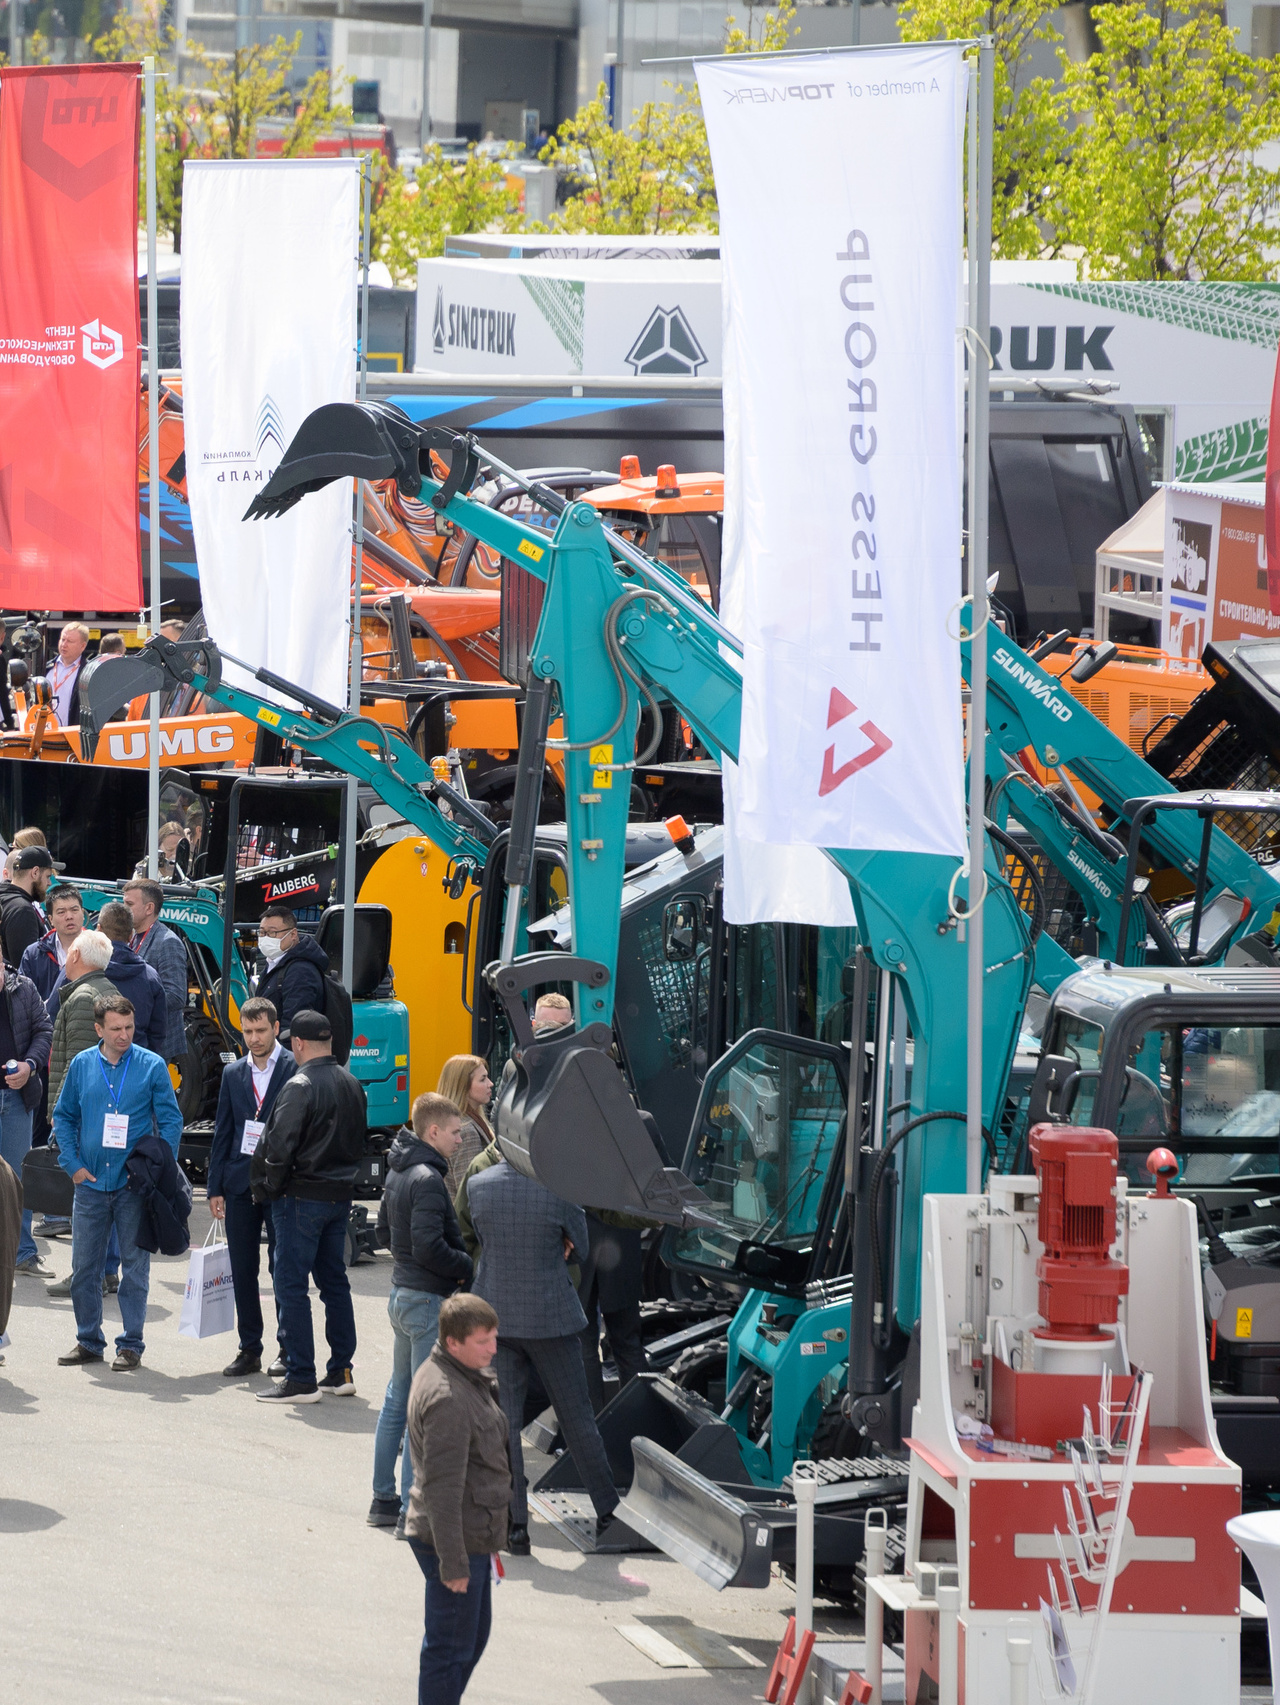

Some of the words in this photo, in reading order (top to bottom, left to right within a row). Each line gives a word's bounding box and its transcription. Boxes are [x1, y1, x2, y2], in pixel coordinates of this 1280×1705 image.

[448, 303, 516, 357] SINOTRUK
[992, 647, 1073, 722] SUNWARD
[109, 725, 234, 761] UMG
[261, 873, 319, 903] ZAUBERG
[1066, 849, 1112, 898] SUNWARD
[158, 907, 210, 925] NWARD
[349, 1048, 380, 1057] NWARD
